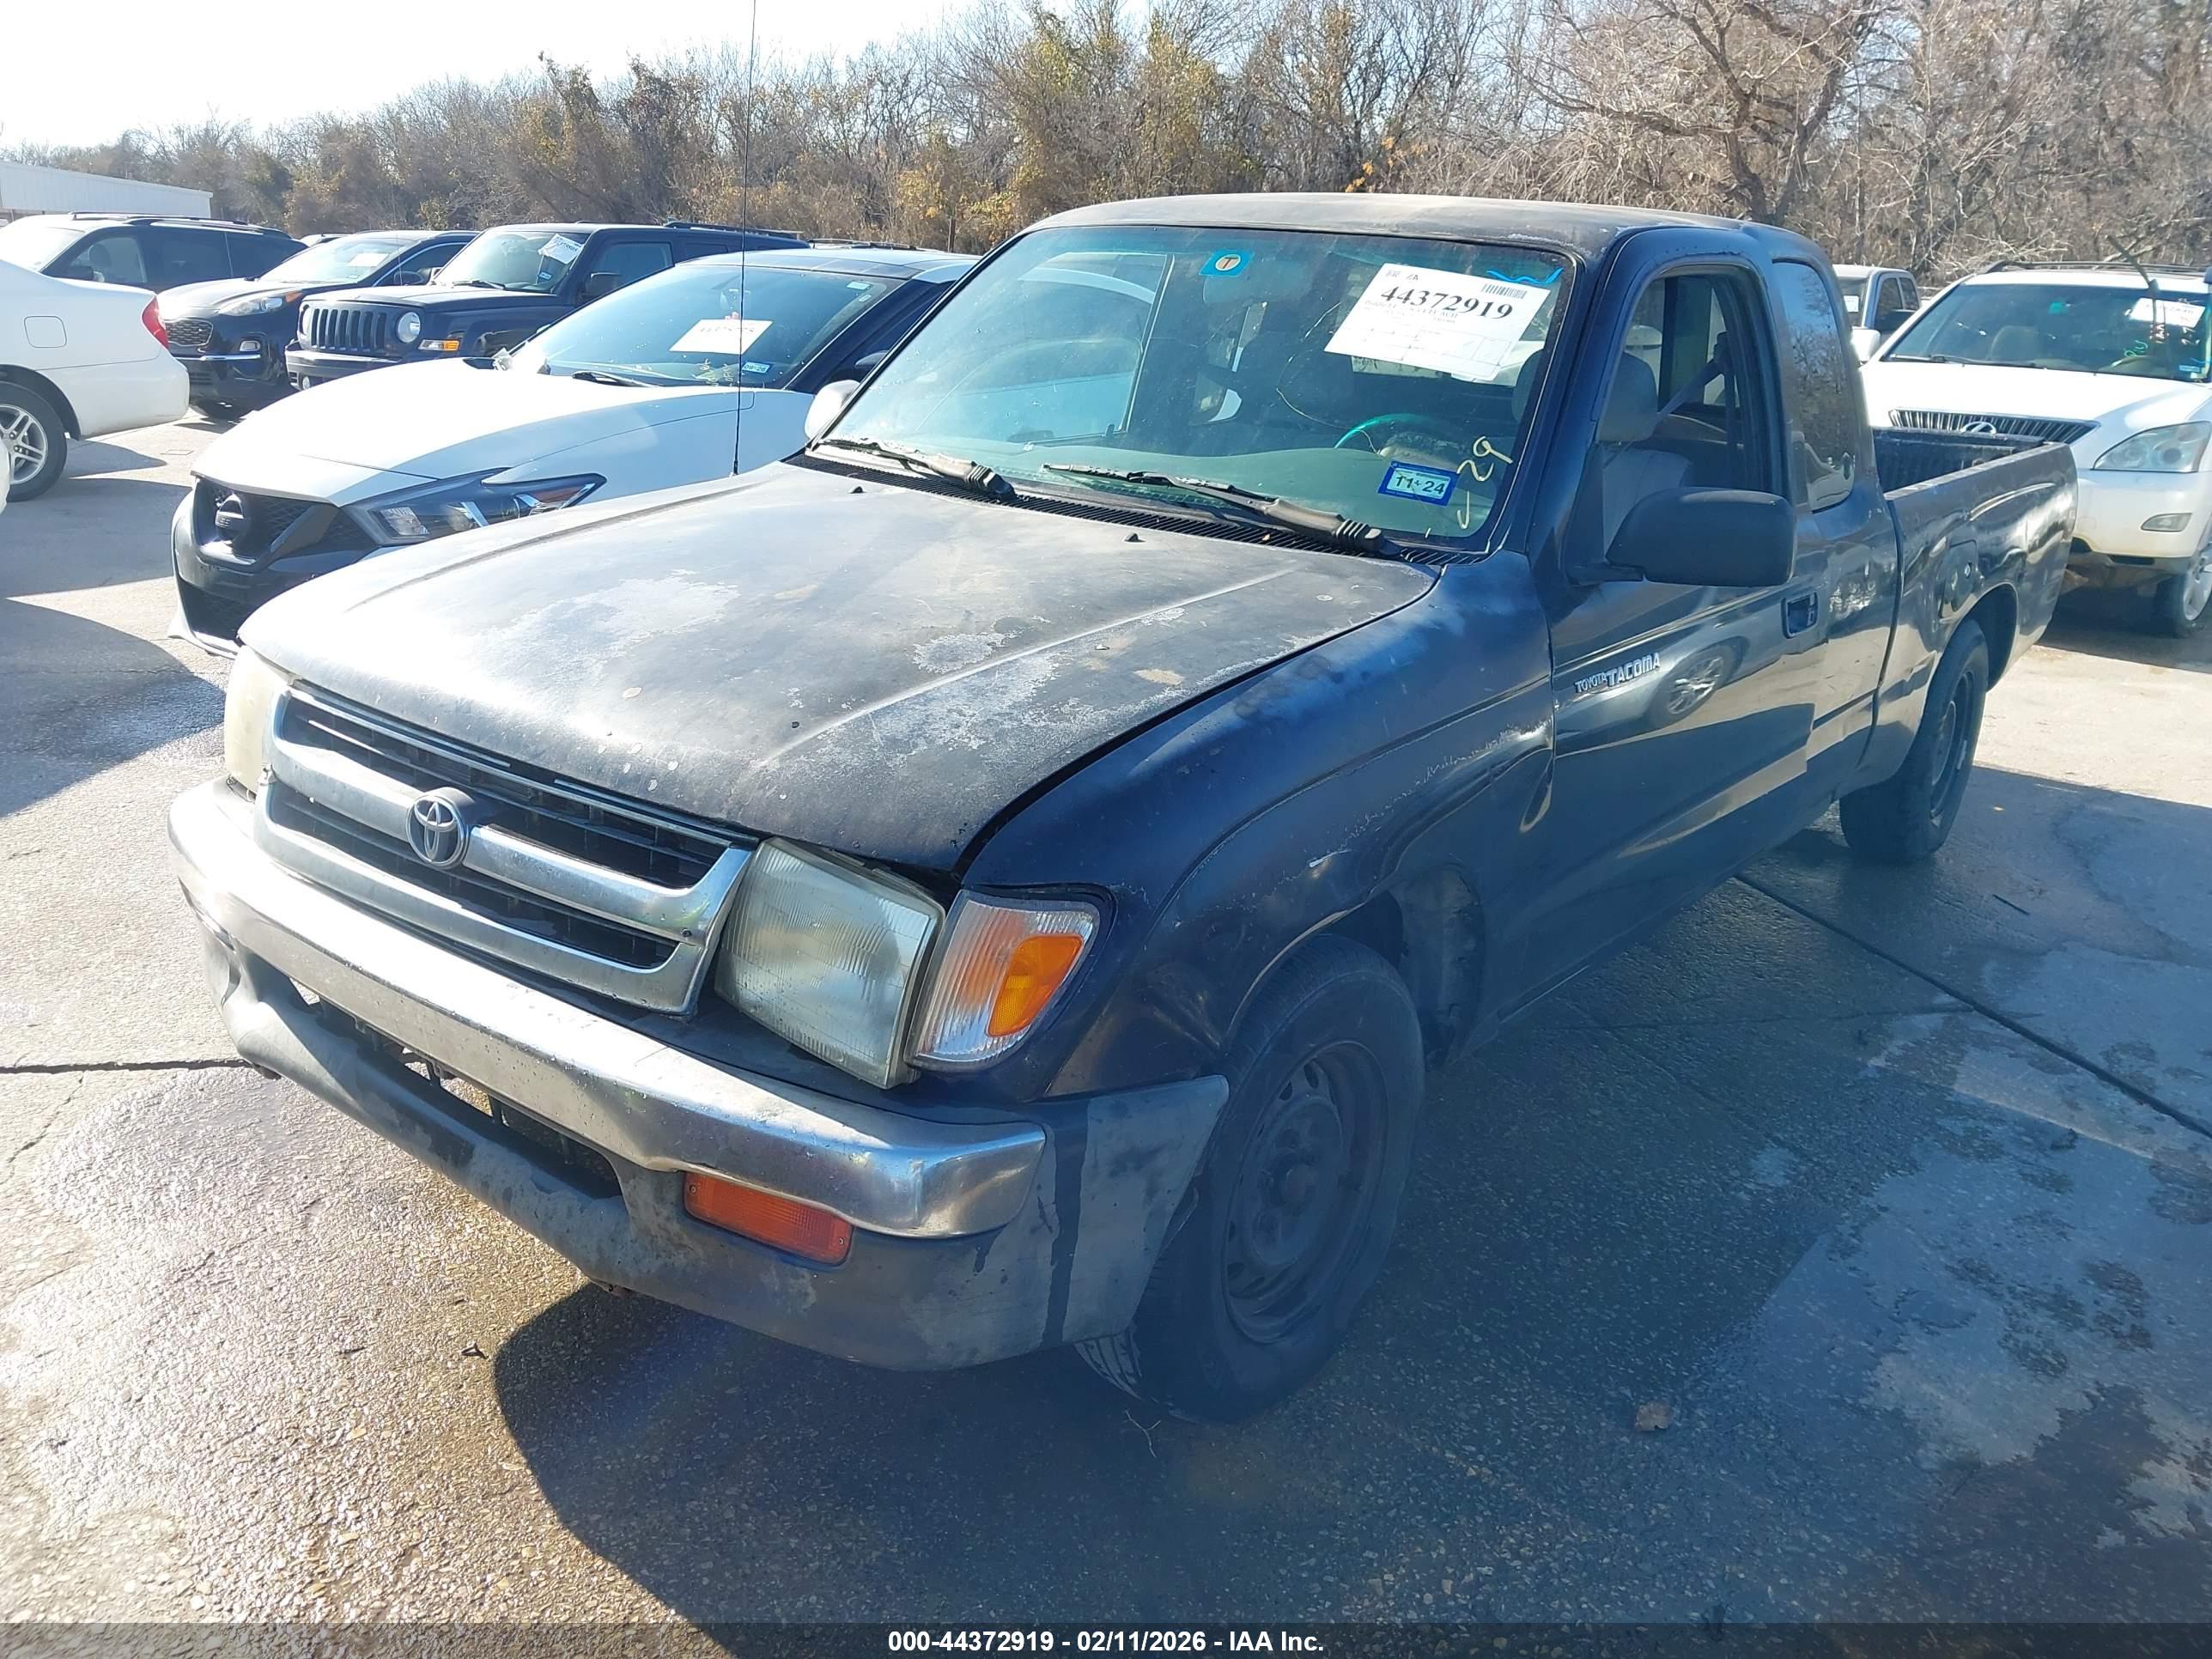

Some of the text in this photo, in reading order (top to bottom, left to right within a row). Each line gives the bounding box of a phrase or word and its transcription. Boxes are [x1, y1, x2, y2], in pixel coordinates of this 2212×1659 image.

[1381, 286, 1513, 320] 44372919
[1575, 653, 1660, 693] TOYOTA TACOMA
